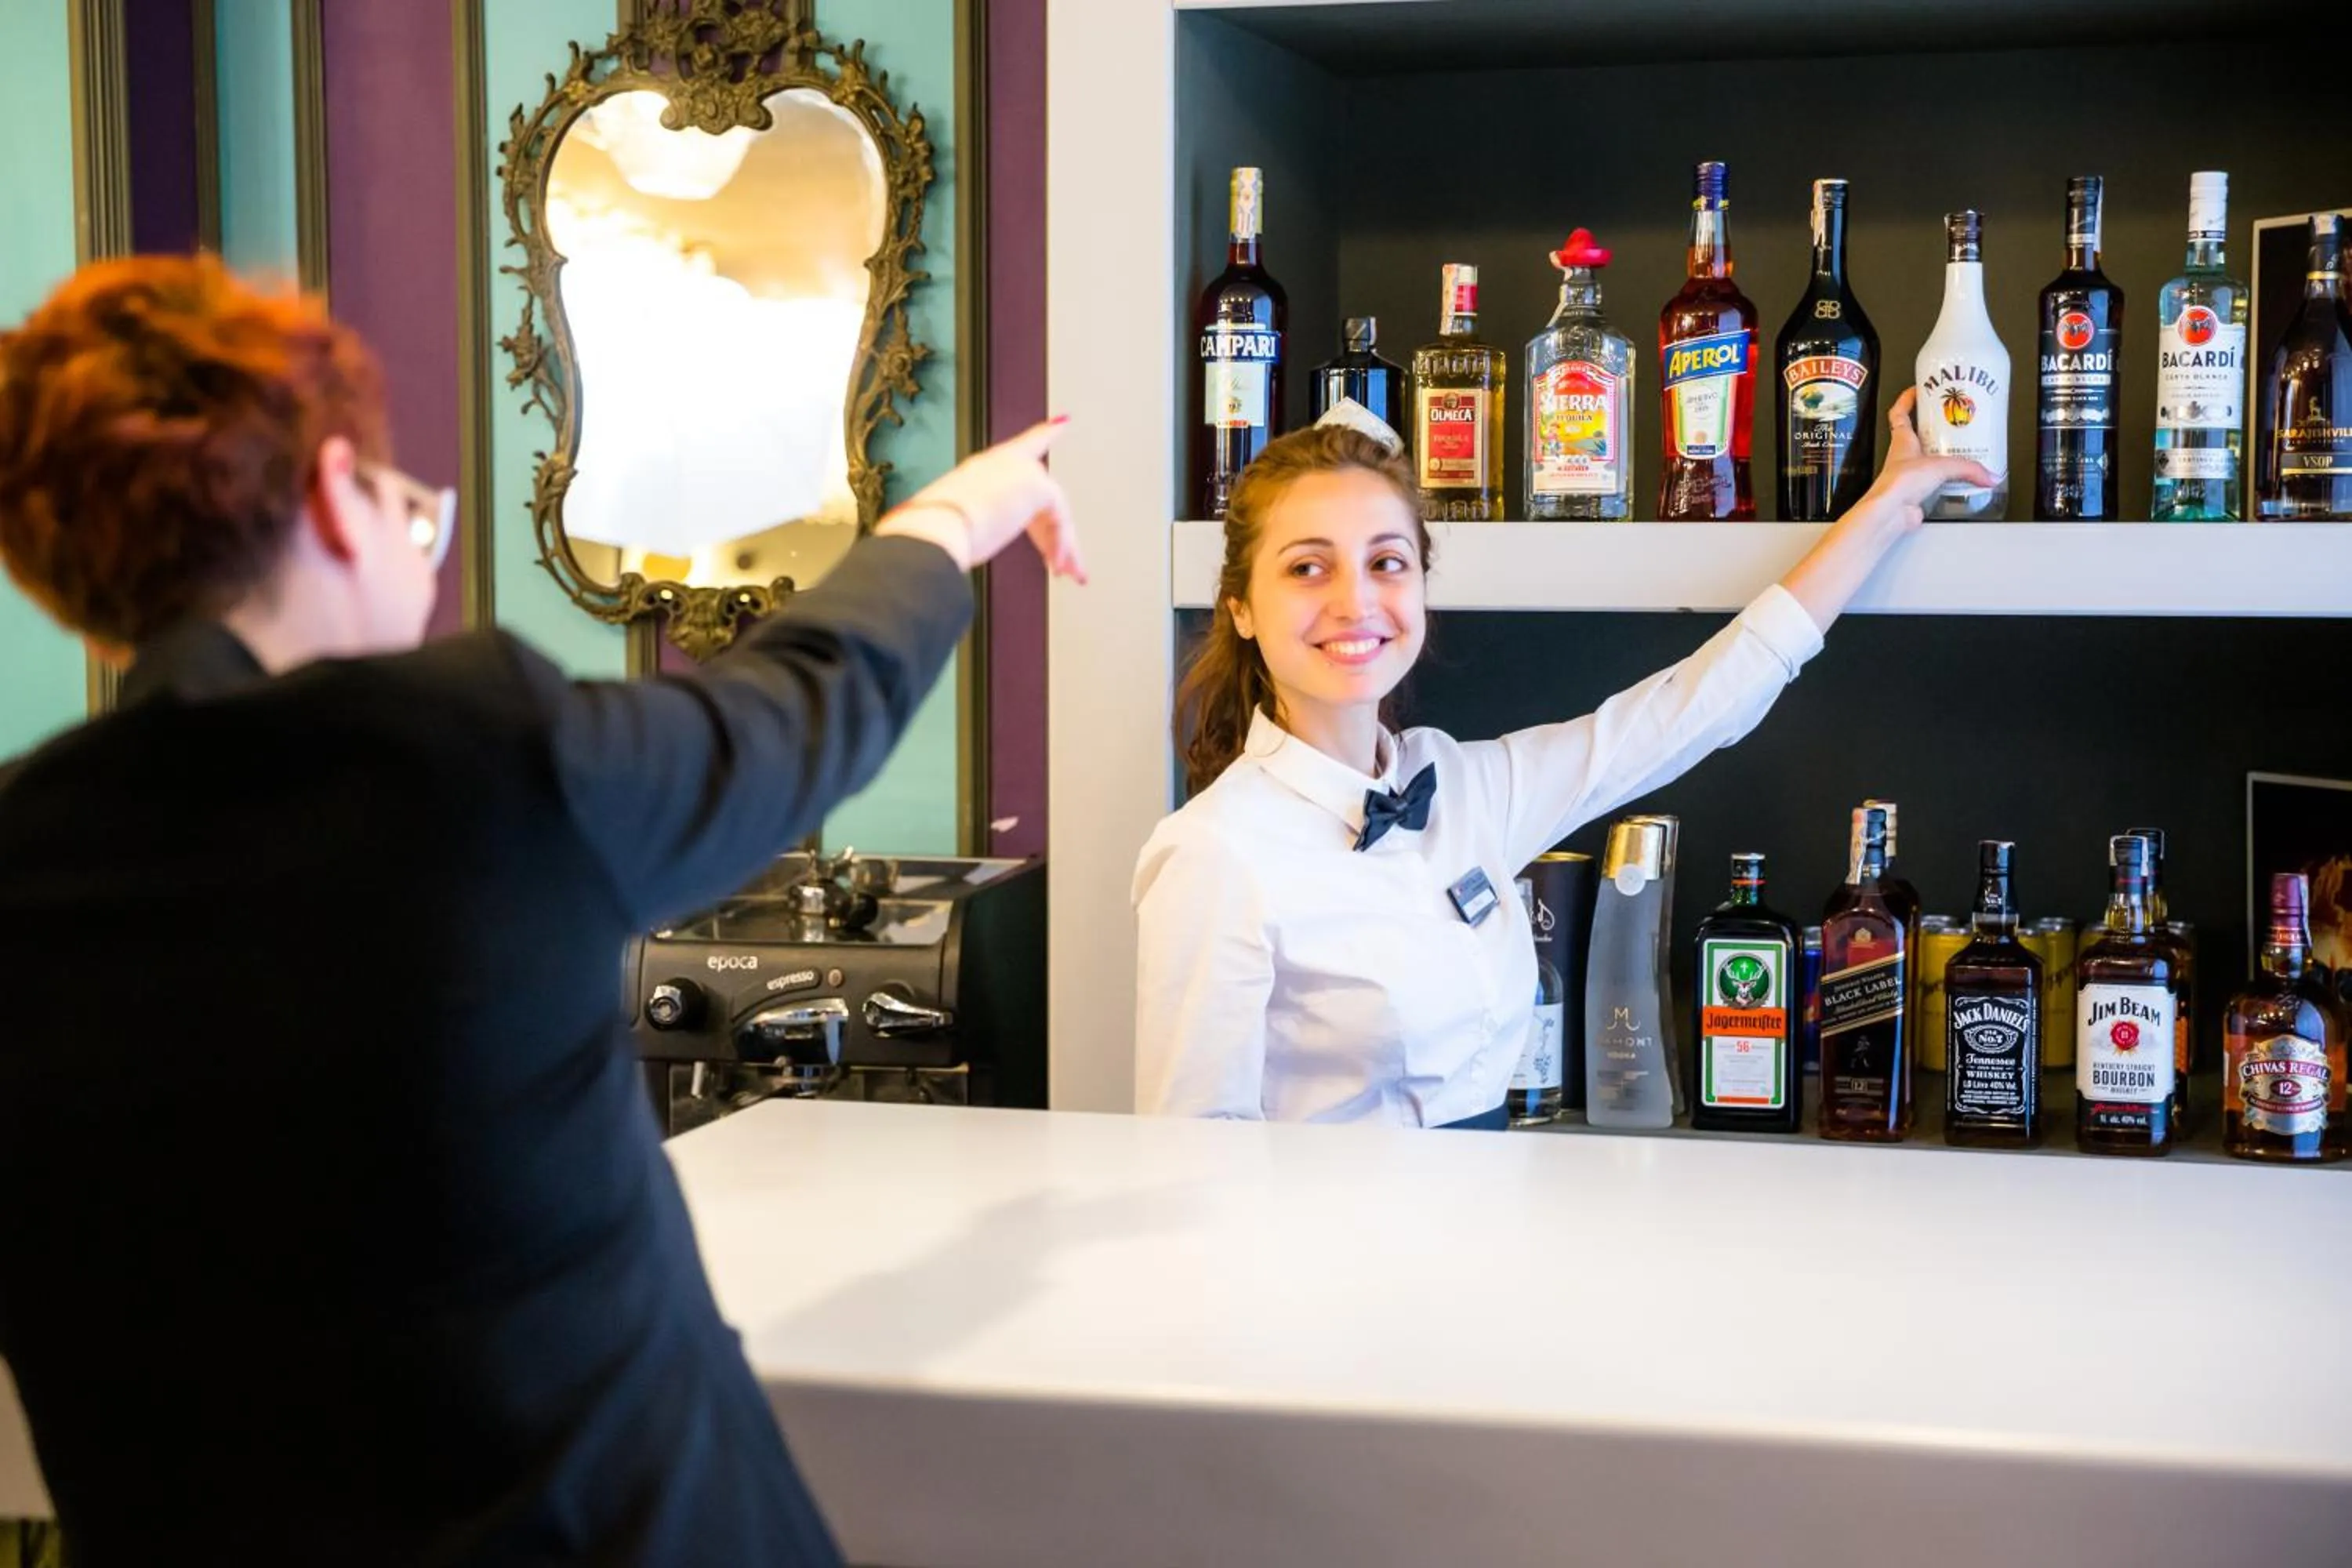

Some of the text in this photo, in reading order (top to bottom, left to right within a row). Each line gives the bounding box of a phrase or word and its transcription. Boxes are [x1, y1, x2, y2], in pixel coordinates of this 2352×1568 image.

[1200, 335, 1276, 357] CAMPARI
[1669, 343, 1740, 379] APEROL
[2042, 349, 2112, 372] BACARDÍ
[2161, 347, 2235, 368] BACARDÍ
[1789, 361, 1861, 382] BAILEYS
[1924, 365, 1999, 397] MALIBU
[1431, 408, 1472, 421] OLMECA
[2303, 456, 2332, 468] VSOP
[707, 956, 758, 972] epoca
[767, 970, 813, 990] espresso
[1824, 988, 1862, 1007] BLACK
[1865, 976, 1902, 995] LABEL
[1953, 1007, 1982, 1029] JACK
[2088, 996, 2161, 1027] JIM BEAM
[1737, 1040, 1749, 1053] 56
[1965, 1053, 2016, 1065] Tennessee
[2092, 1070, 2155, 1087] BOURBON
[2243, 1062, 2328, 1080] CHIVAS REGAL
[2279, 1081, 2292, 1095] 12
